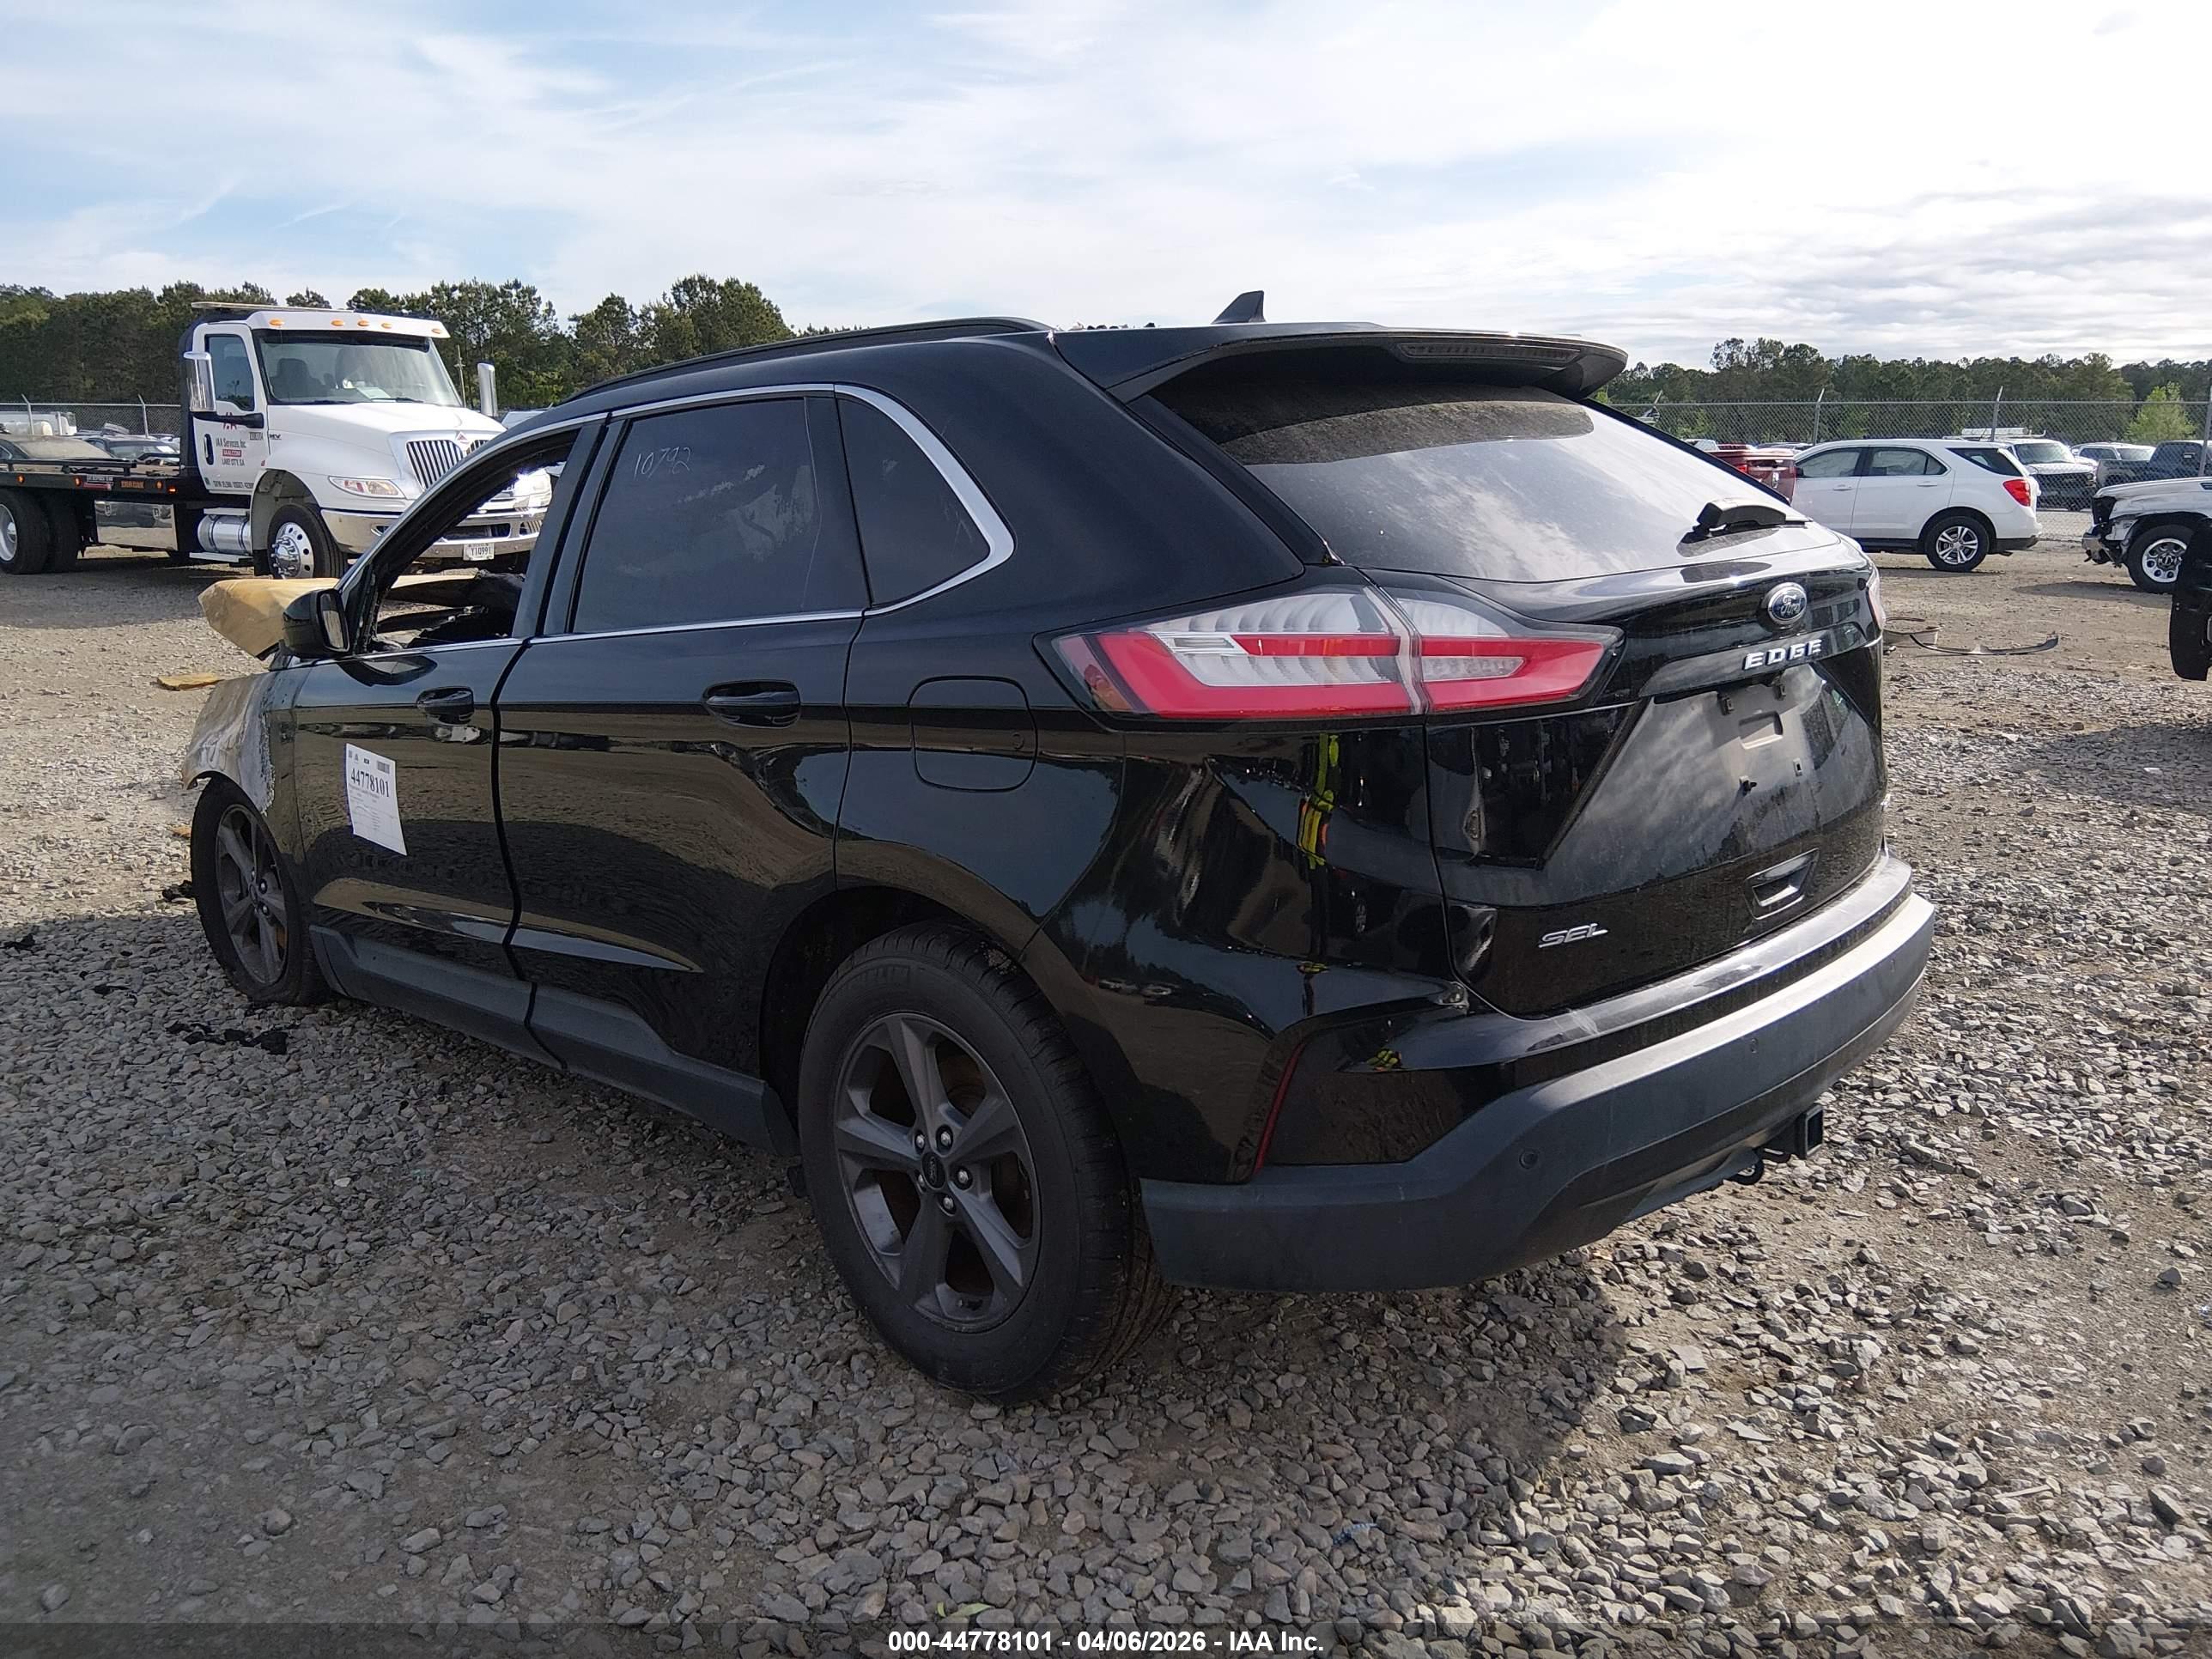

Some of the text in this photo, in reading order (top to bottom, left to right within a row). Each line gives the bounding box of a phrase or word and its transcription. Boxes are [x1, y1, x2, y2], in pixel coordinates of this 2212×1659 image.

[1780, 594, 1802, 615] Ford
[1743, 639, 1822, 670] EDGE
[351, 768, 389, 797] 44778101
[1538, 923, 1608, 948] SEL
